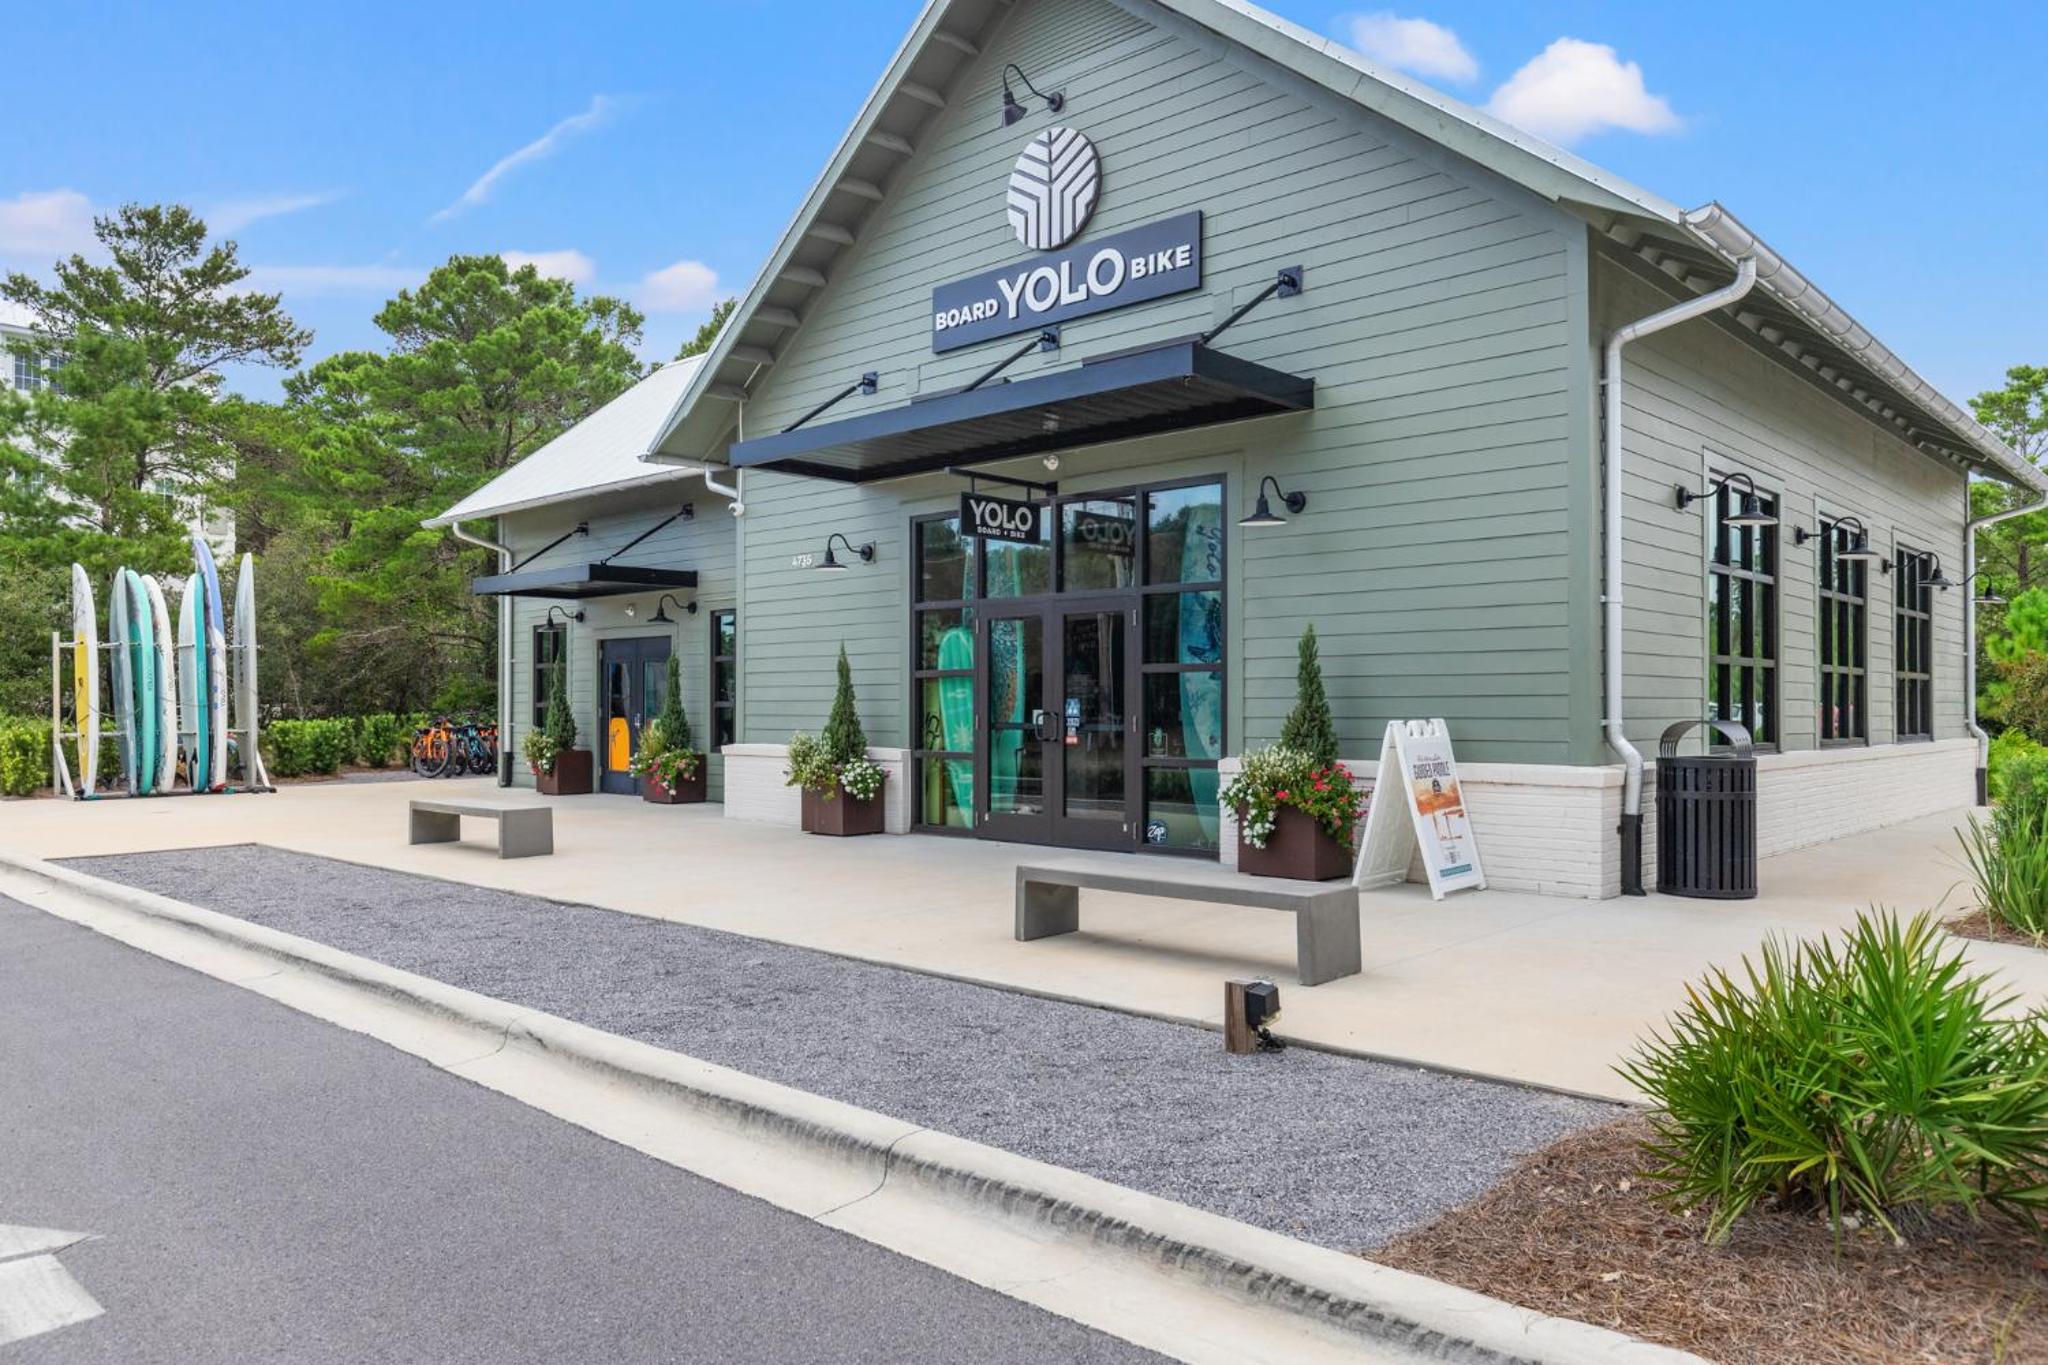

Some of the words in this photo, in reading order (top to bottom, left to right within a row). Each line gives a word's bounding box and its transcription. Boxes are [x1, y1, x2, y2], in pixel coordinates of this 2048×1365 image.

[935, 299, 999, 331] BOARD
[998, 248, 1125, 319] YOLO
[1131, 244, 1193, 280] BIKE
[969, 499, 1033, 532] YOLO
